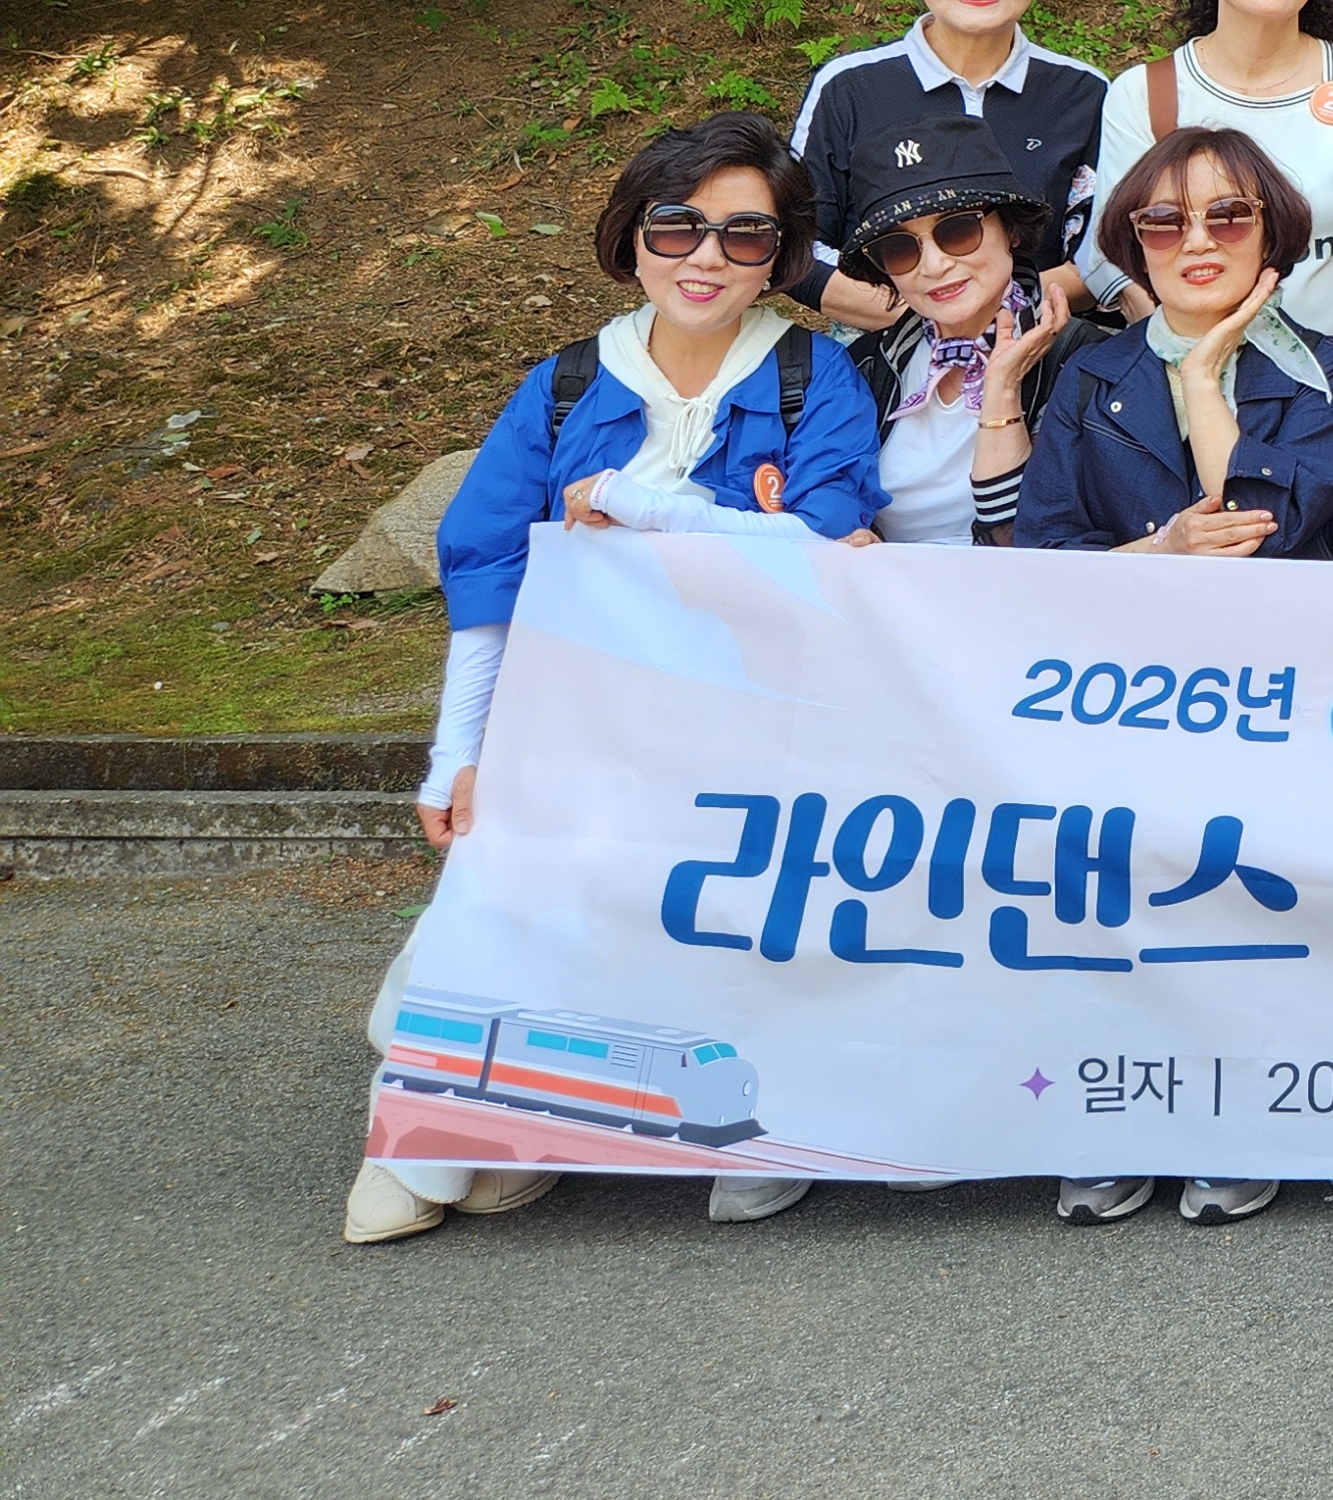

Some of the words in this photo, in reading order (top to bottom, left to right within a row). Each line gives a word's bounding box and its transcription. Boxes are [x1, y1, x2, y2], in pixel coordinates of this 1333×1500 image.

[894, 139, 923, 168] NY
[767, 475, 782, 498] 2
[1011, 658, 1296, 743] 2026년
[660, 791, 1310, 973] 라인댄스
[1077, 1054, 1184, 1115] 일자
